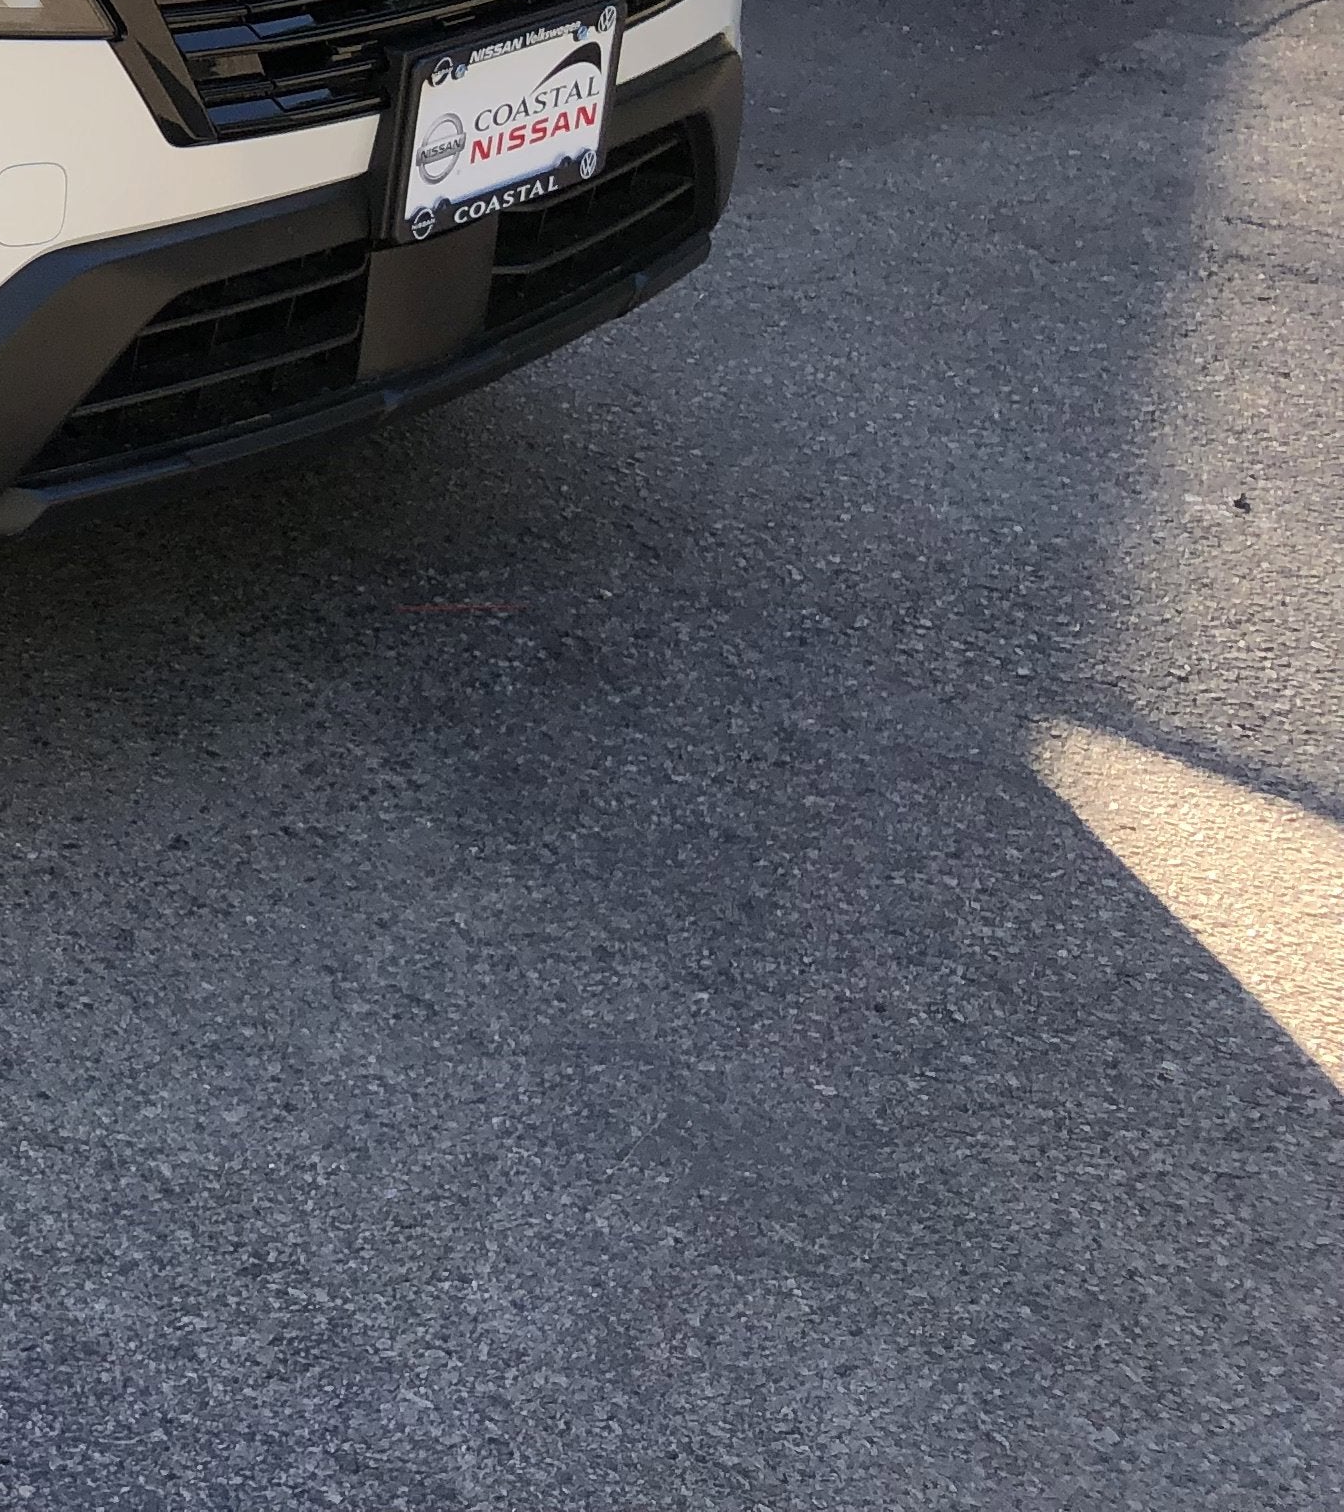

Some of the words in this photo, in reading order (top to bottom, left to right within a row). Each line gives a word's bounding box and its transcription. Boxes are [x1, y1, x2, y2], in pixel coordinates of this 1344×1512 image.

[469, 36, 524, 63] NISSAN
[474, 76, 600, 132] COASTAL
[421, 138, 461, 161] NISSAN
[470, 102, 598, 164] NISSAN
[454, 176, 559, 224] COASTAL
